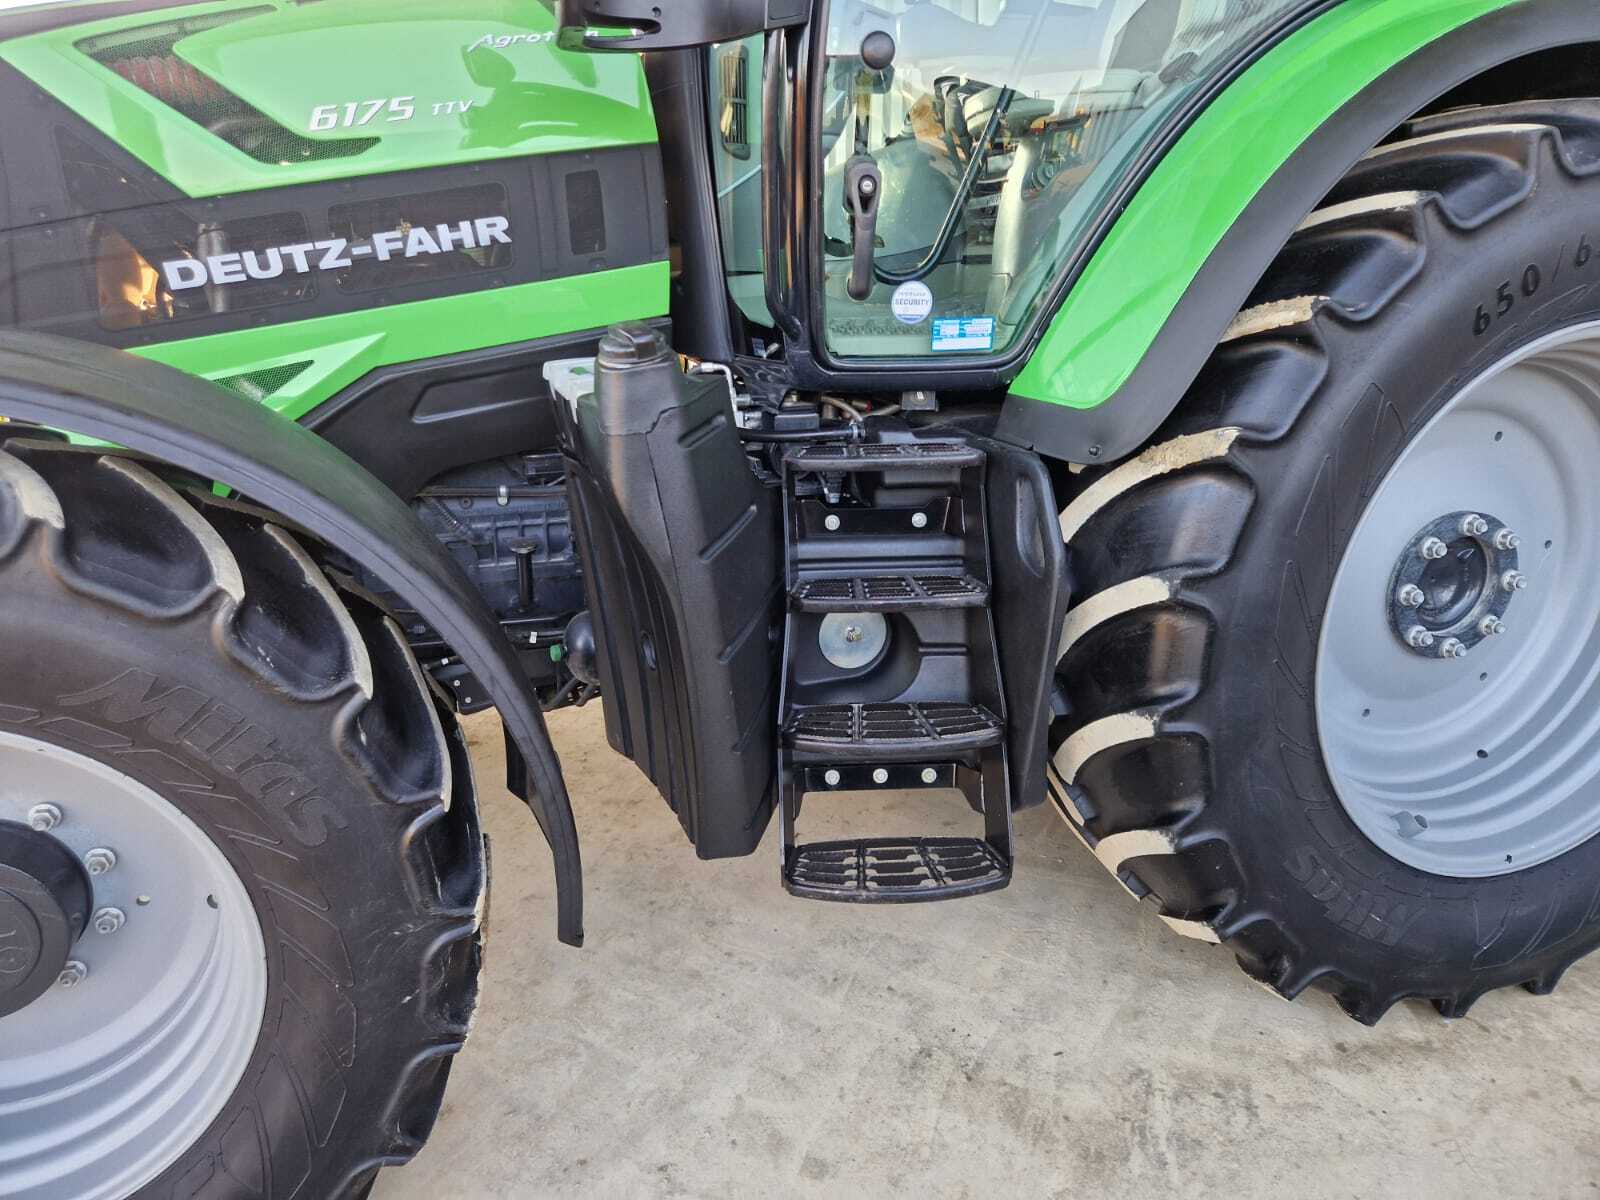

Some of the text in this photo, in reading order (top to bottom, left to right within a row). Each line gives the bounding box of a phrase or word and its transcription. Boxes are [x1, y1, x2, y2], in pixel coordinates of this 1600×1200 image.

[309, 95, 473, 132] 6175 TTV
[162, 215, 512, 292] DEUTZ-FAHR
[1472, 231, 1600, 336] 650/6
